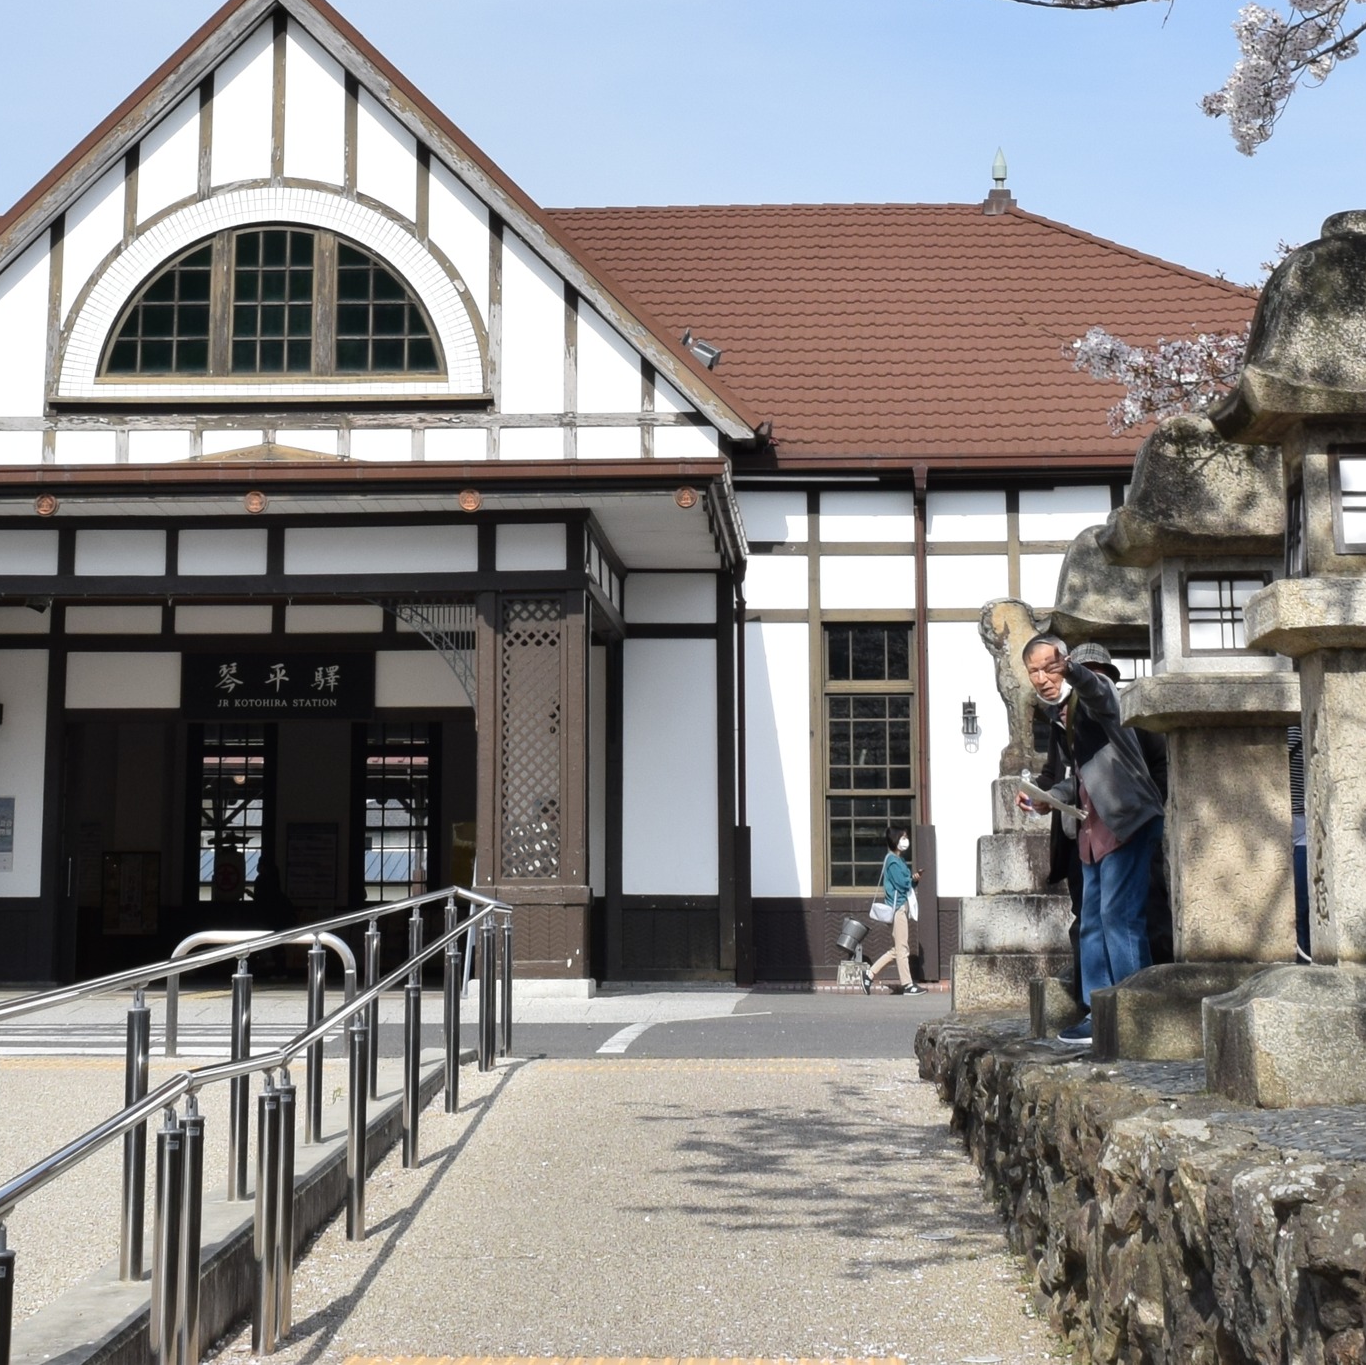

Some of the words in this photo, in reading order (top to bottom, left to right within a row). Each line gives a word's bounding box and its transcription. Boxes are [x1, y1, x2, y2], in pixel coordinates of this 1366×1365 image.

[217, 699, 229, 708] JR
[234, 699, 288, 707] KOTOHIRA
[292, 699, 337, 707] STATION
